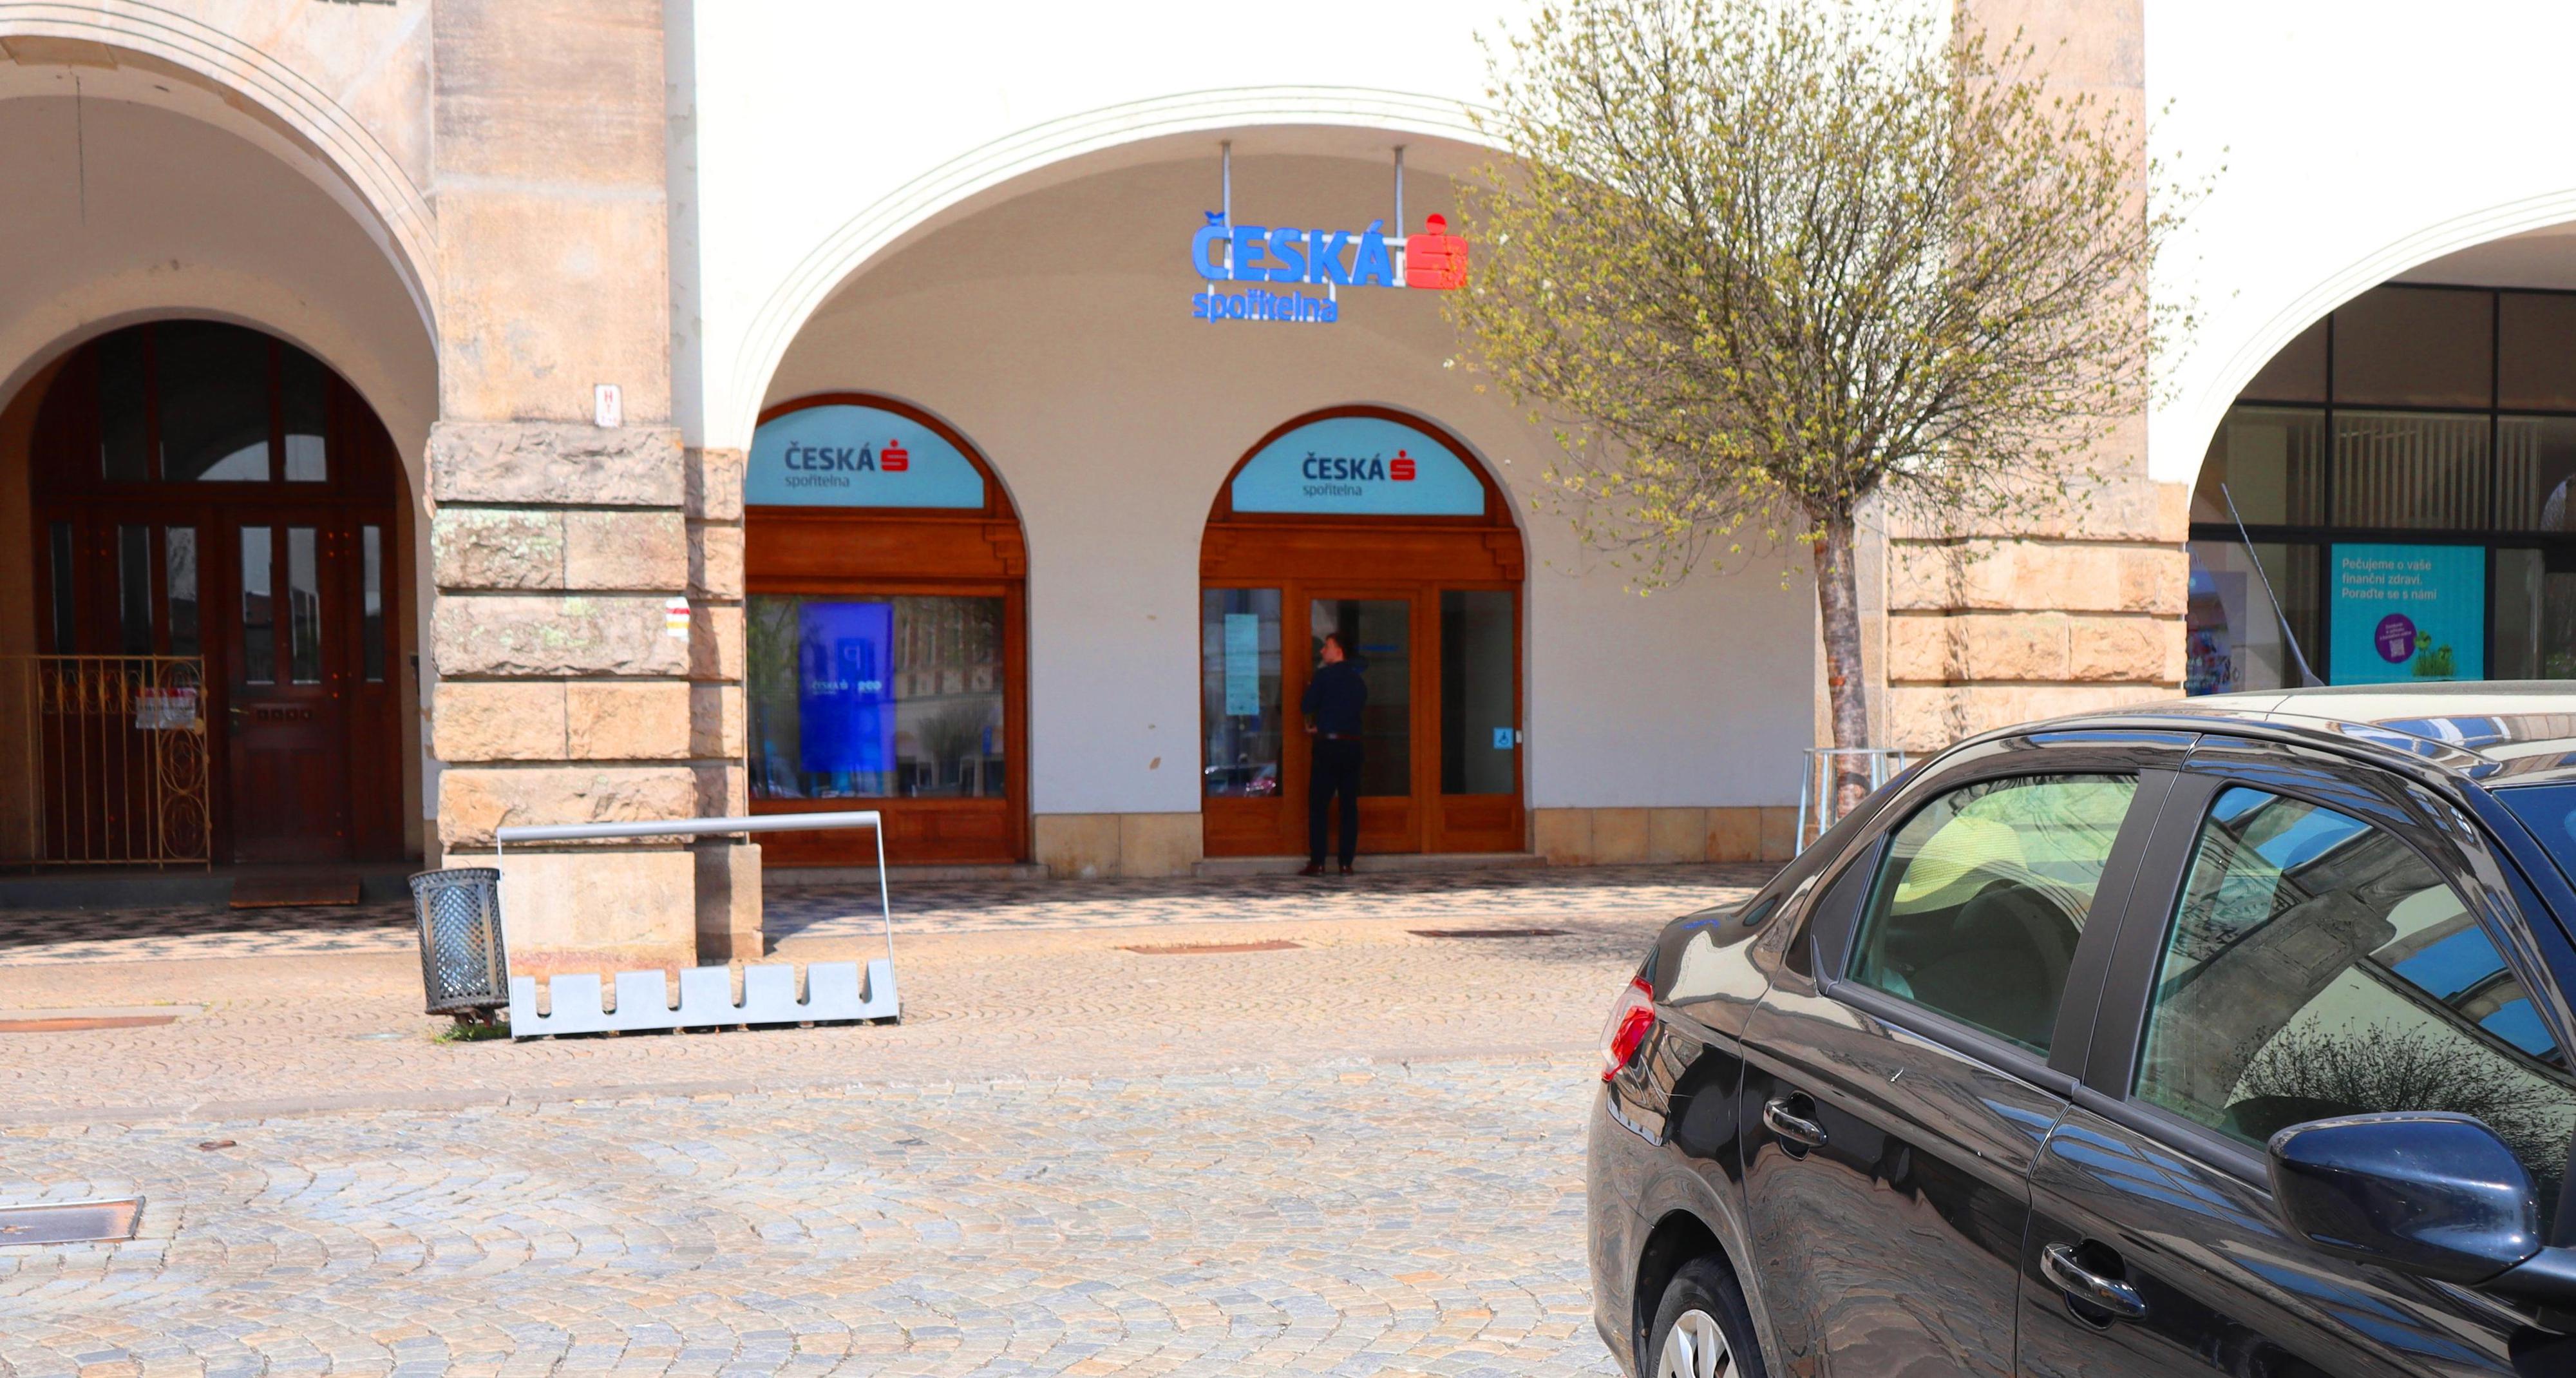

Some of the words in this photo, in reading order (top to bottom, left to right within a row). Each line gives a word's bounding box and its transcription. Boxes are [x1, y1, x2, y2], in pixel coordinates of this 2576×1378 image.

[1192, 211, 1393, 287] ČESKÁ
[1192, 288, 1338, 323] spořitelna
[784, 441, 875, 472] ČESKÁ
[1303, 452, 1385, 481] ČESKÁ
[785, 474, 849, 488] spořitelna
[1303, 483, 1362, 497] spořitelna
[2342, 557, 2394, 571] Pečujeme
[2407, 559, 2432, 570] vaše
[2342, 573, 2385, 584] finanční
[2389, 573, 2422, 585] zdraví.
[2342, 588, 2384, 598] Poraďte
[2387, 591, 2400, 599] se
[2412, 588, 2438, 600] námi
